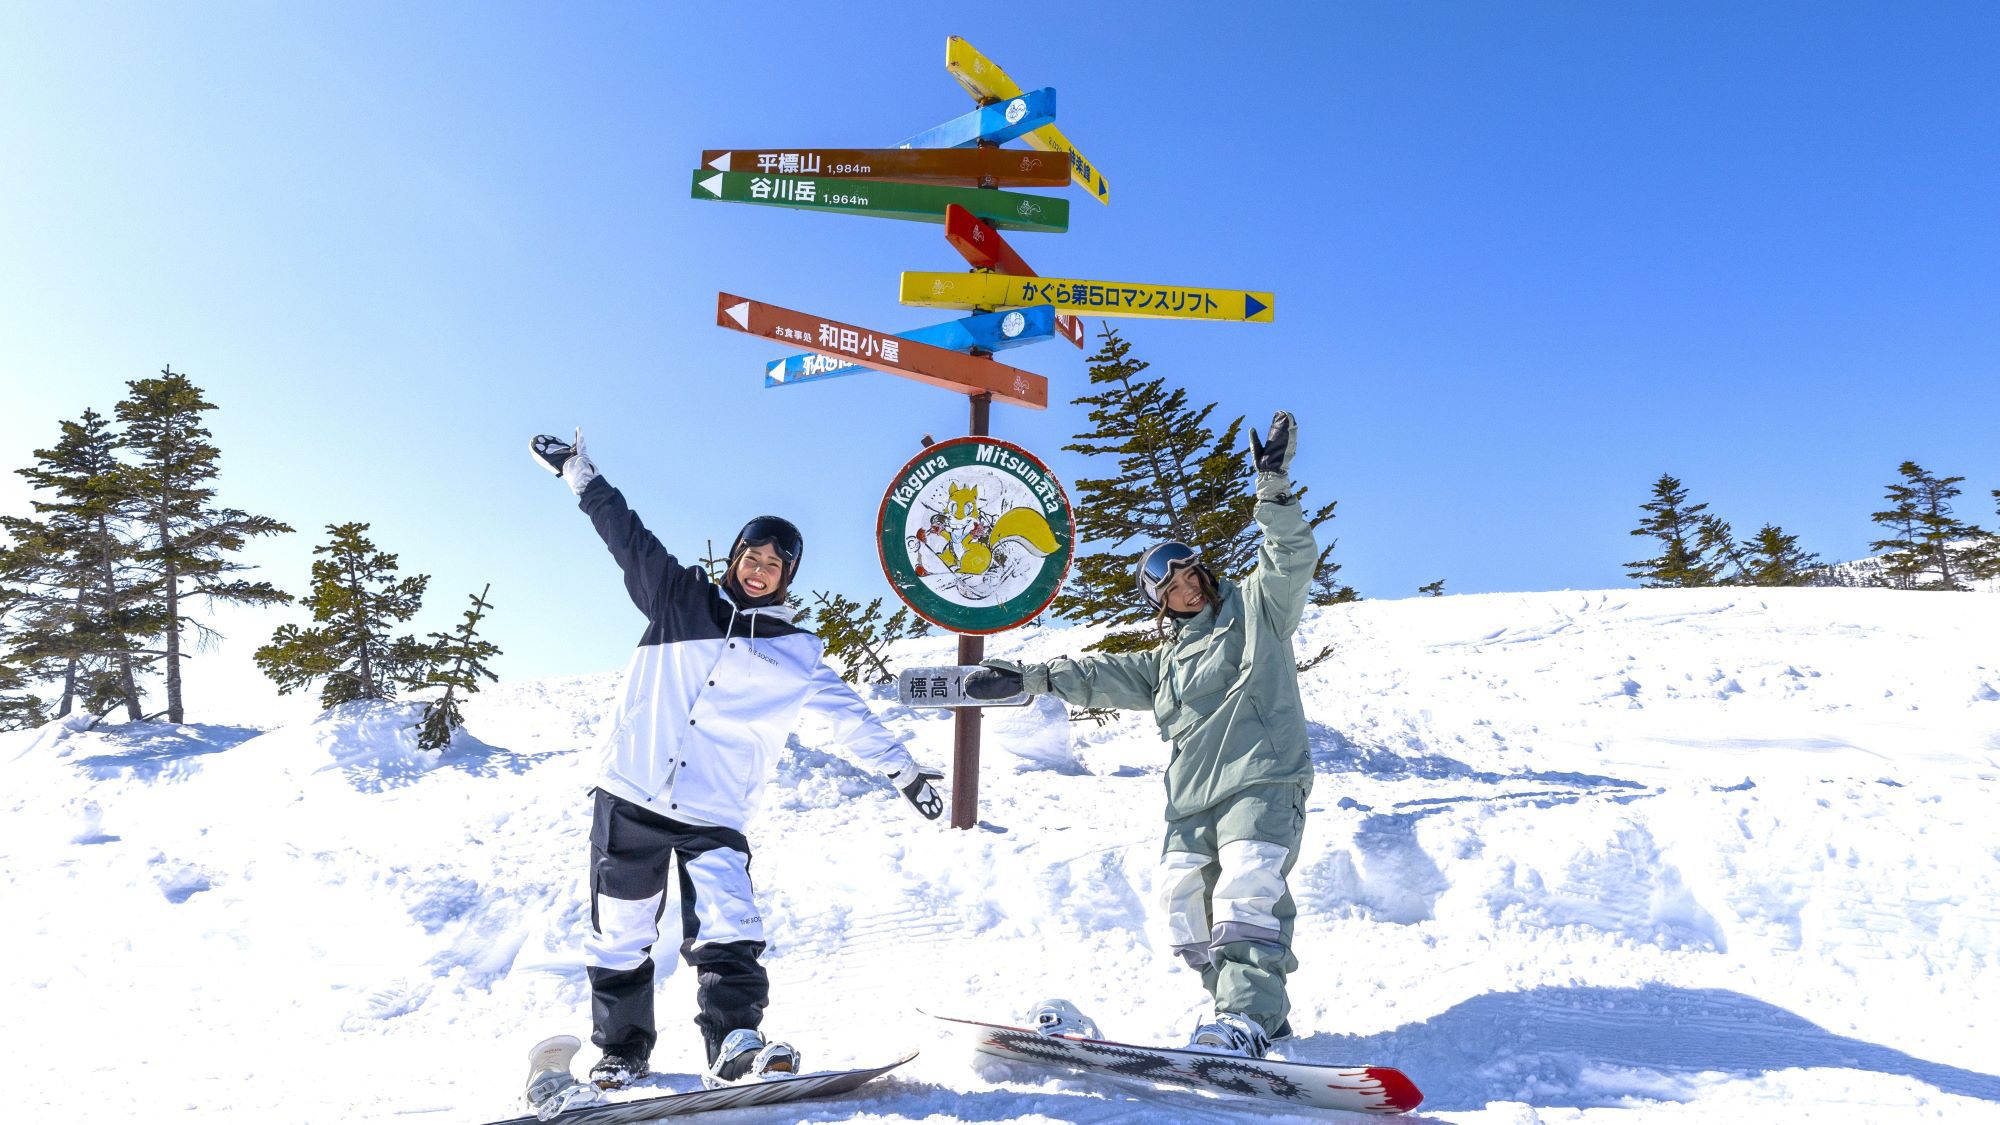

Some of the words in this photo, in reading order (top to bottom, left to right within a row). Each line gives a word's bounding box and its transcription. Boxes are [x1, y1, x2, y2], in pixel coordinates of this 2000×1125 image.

[757, 153, 820, 173] 平標山
[826, 164, 871, 175] 1,984m
[750, 177, 816, 202] 谷川岳
[823, 194, 869, 206] 1,964m
[1022, 282, 1218, 313] かぐら第5ロマンスリフト
[775, 325, 812, 343] お食事処
[818, 323, 899, 363] 和田小屋
[891, 455, 949, 509] Kagura
[975, 444, 1060, 513] Mitsumata
